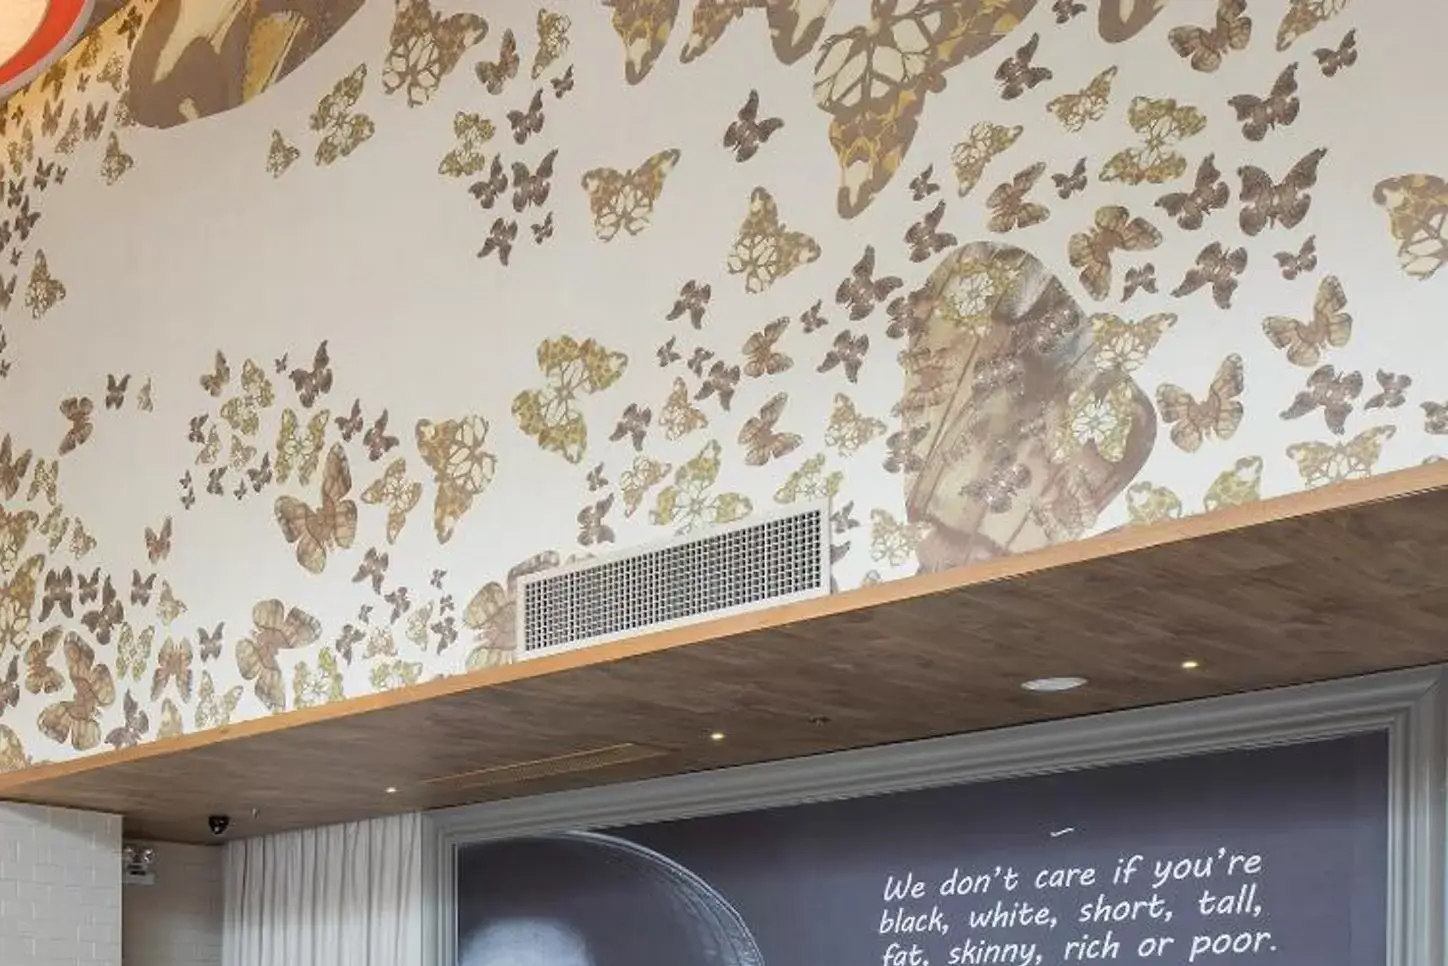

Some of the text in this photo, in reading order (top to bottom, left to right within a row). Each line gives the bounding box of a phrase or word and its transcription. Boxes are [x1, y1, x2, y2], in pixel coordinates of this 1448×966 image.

[883, 872, 926, 902] We
[1035, 868, 1096, 890] care
[1113, 855, 1144, 885] if
[879, 883, 1262, 935] black, white, short, tall,
[1064, 930, 1120, 960] rich
[1138, 937, 1174, 957] or
[1189, 931, 1278, 963] poor.
